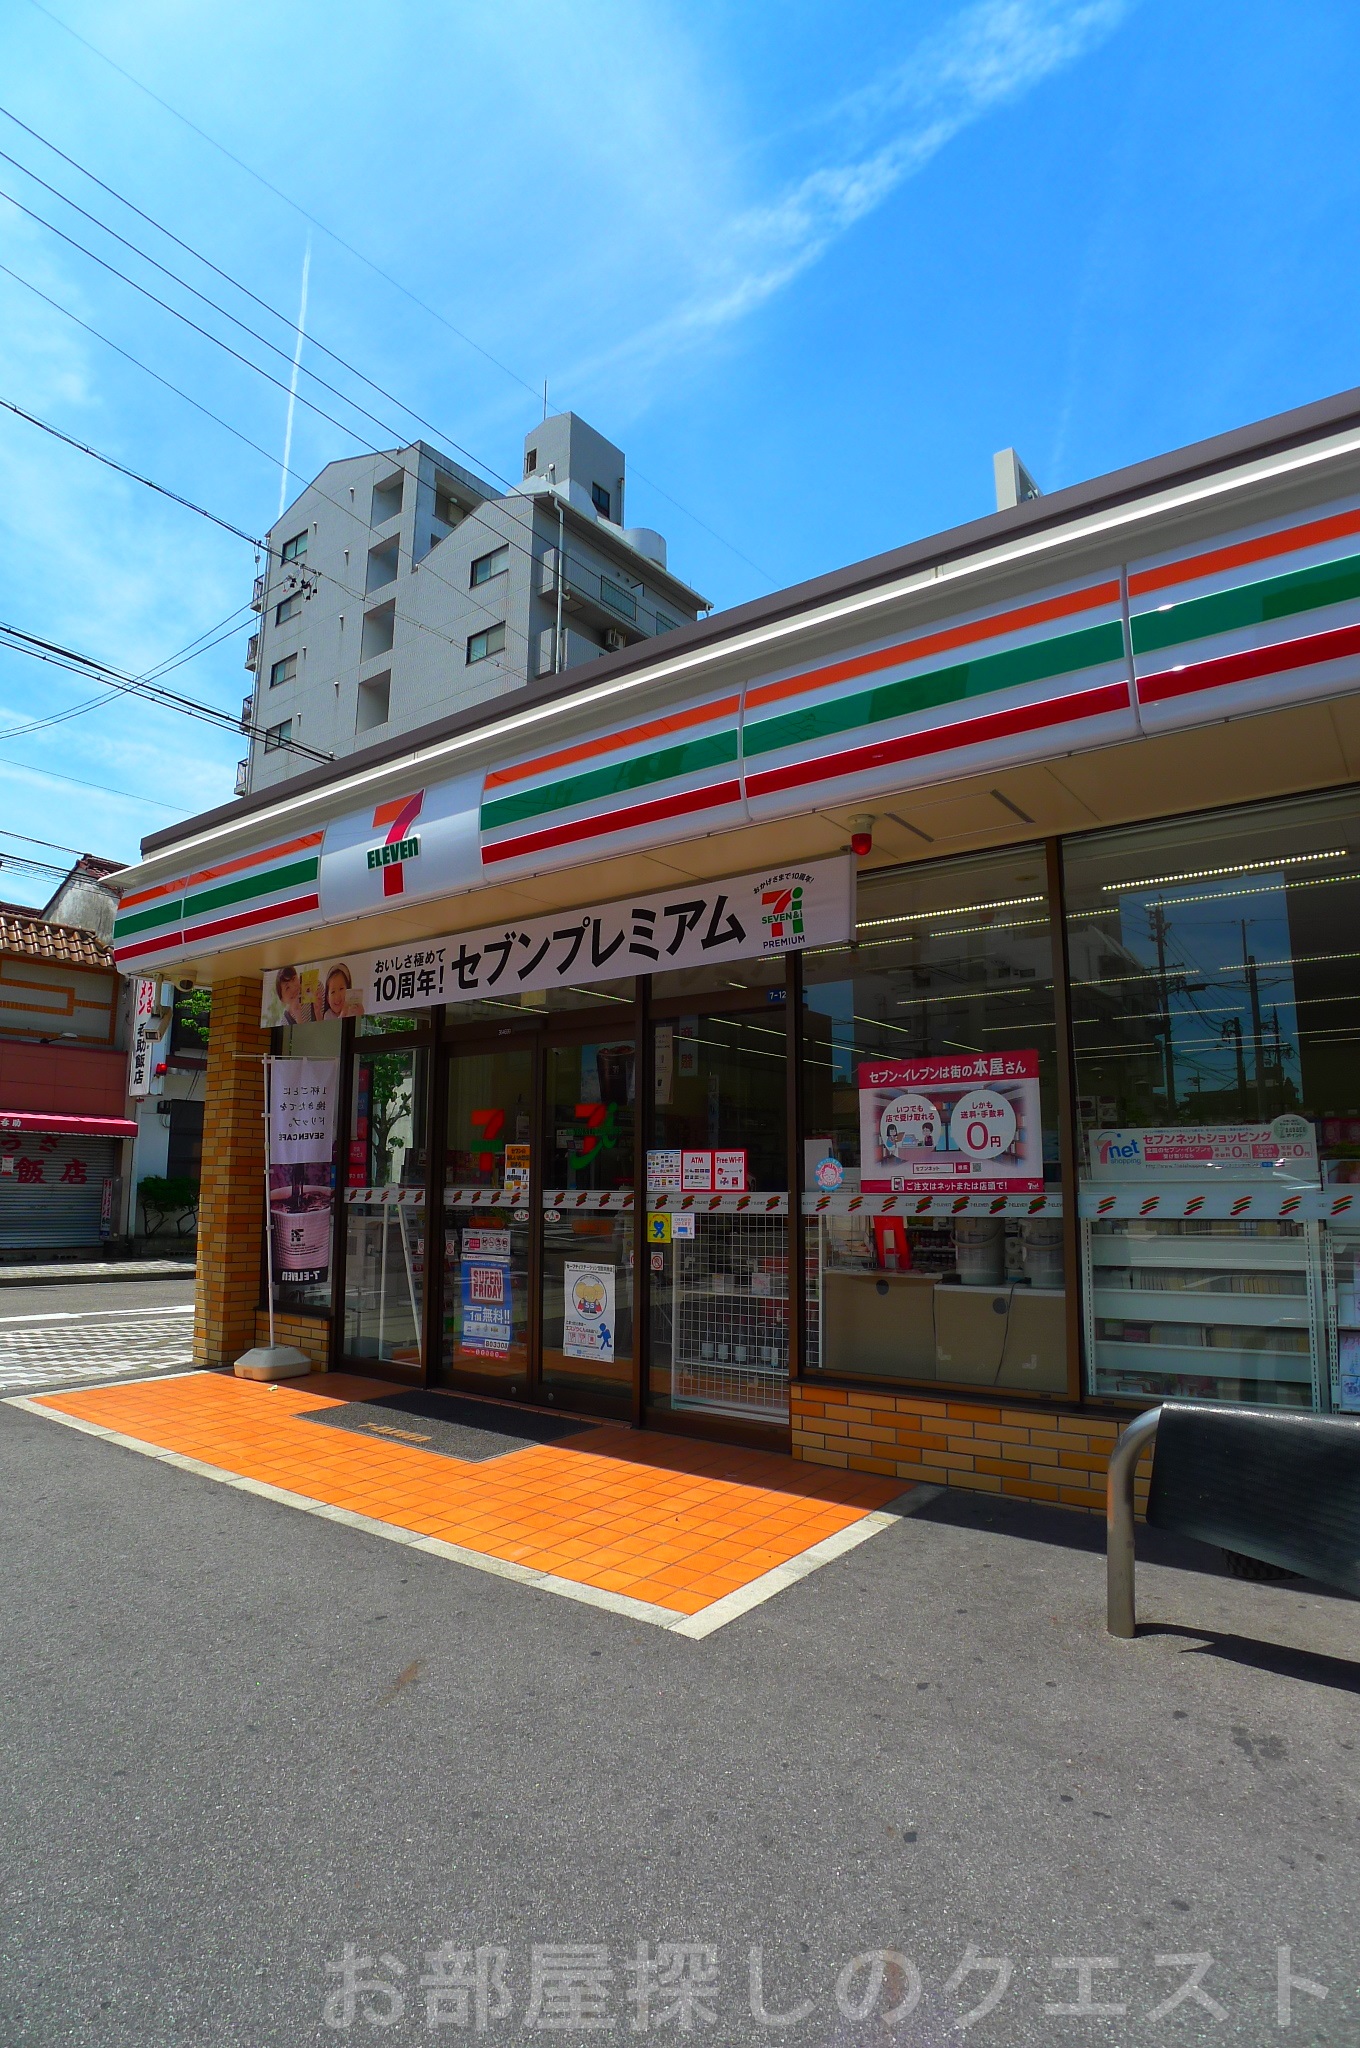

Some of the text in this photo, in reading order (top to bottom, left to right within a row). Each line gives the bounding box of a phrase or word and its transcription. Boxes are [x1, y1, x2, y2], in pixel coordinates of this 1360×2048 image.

[372, 788, 425, 897] 7
[451, 894, 747, 990] セブンプレミアム
[763, 935, 806, 949] PREMIUM
[374, 948, 447, 974] おいしさ極めて
[373, 965, 445, 1002] 10周年!
[768, 990, 787, 1000] 7-12
[896, 1104, 924, 1113] いつでも
[971, 1101, 993, 1109] しかも
[885, 1113, 935, 1123] 店で受け取れる
[1142, 1131, 1272, 1145] セブンネットショッピング
[690, 1156, 704, 1164] ATM
[716, 1156, 744, 1164] Free Wi-Fi
[1110, 1158, 1142, 1166] shopping
[473, 1283, 502, 1299] FRIDAY
